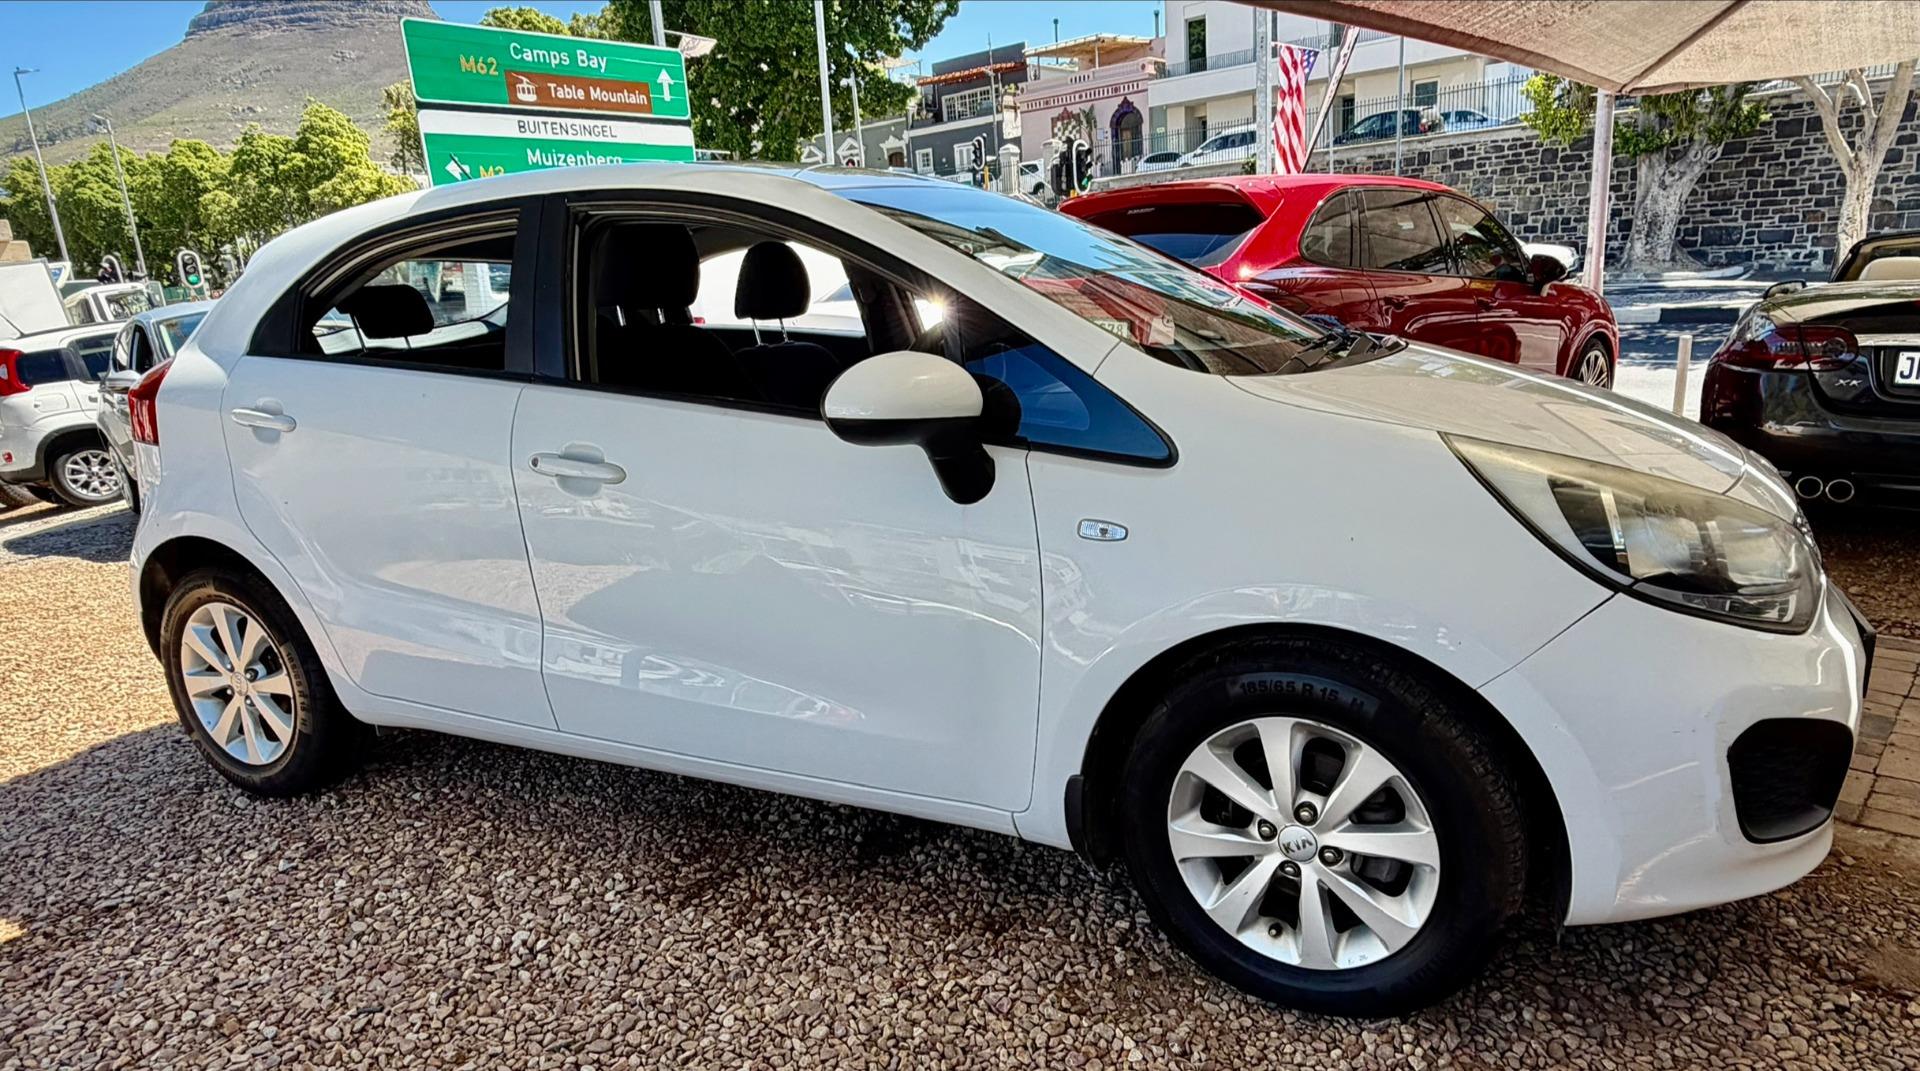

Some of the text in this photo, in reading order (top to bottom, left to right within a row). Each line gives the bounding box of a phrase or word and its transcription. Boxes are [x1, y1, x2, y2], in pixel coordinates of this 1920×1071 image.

[459, 54, 499, 77] M62
[509, 42, 607, 73] Camps Bay
[547, 81, 648, 106] Table Mountain
[517, 119, 618, 139] BUITENSINGEL
[1899, 356, 1920, 380] J
[1239, 679, 1297, 696] 185/65
[1301, 682, 1314, 696] R
[1319, 686, 1340, 701] 15
[1281, 838, 1314, 854] KIA
